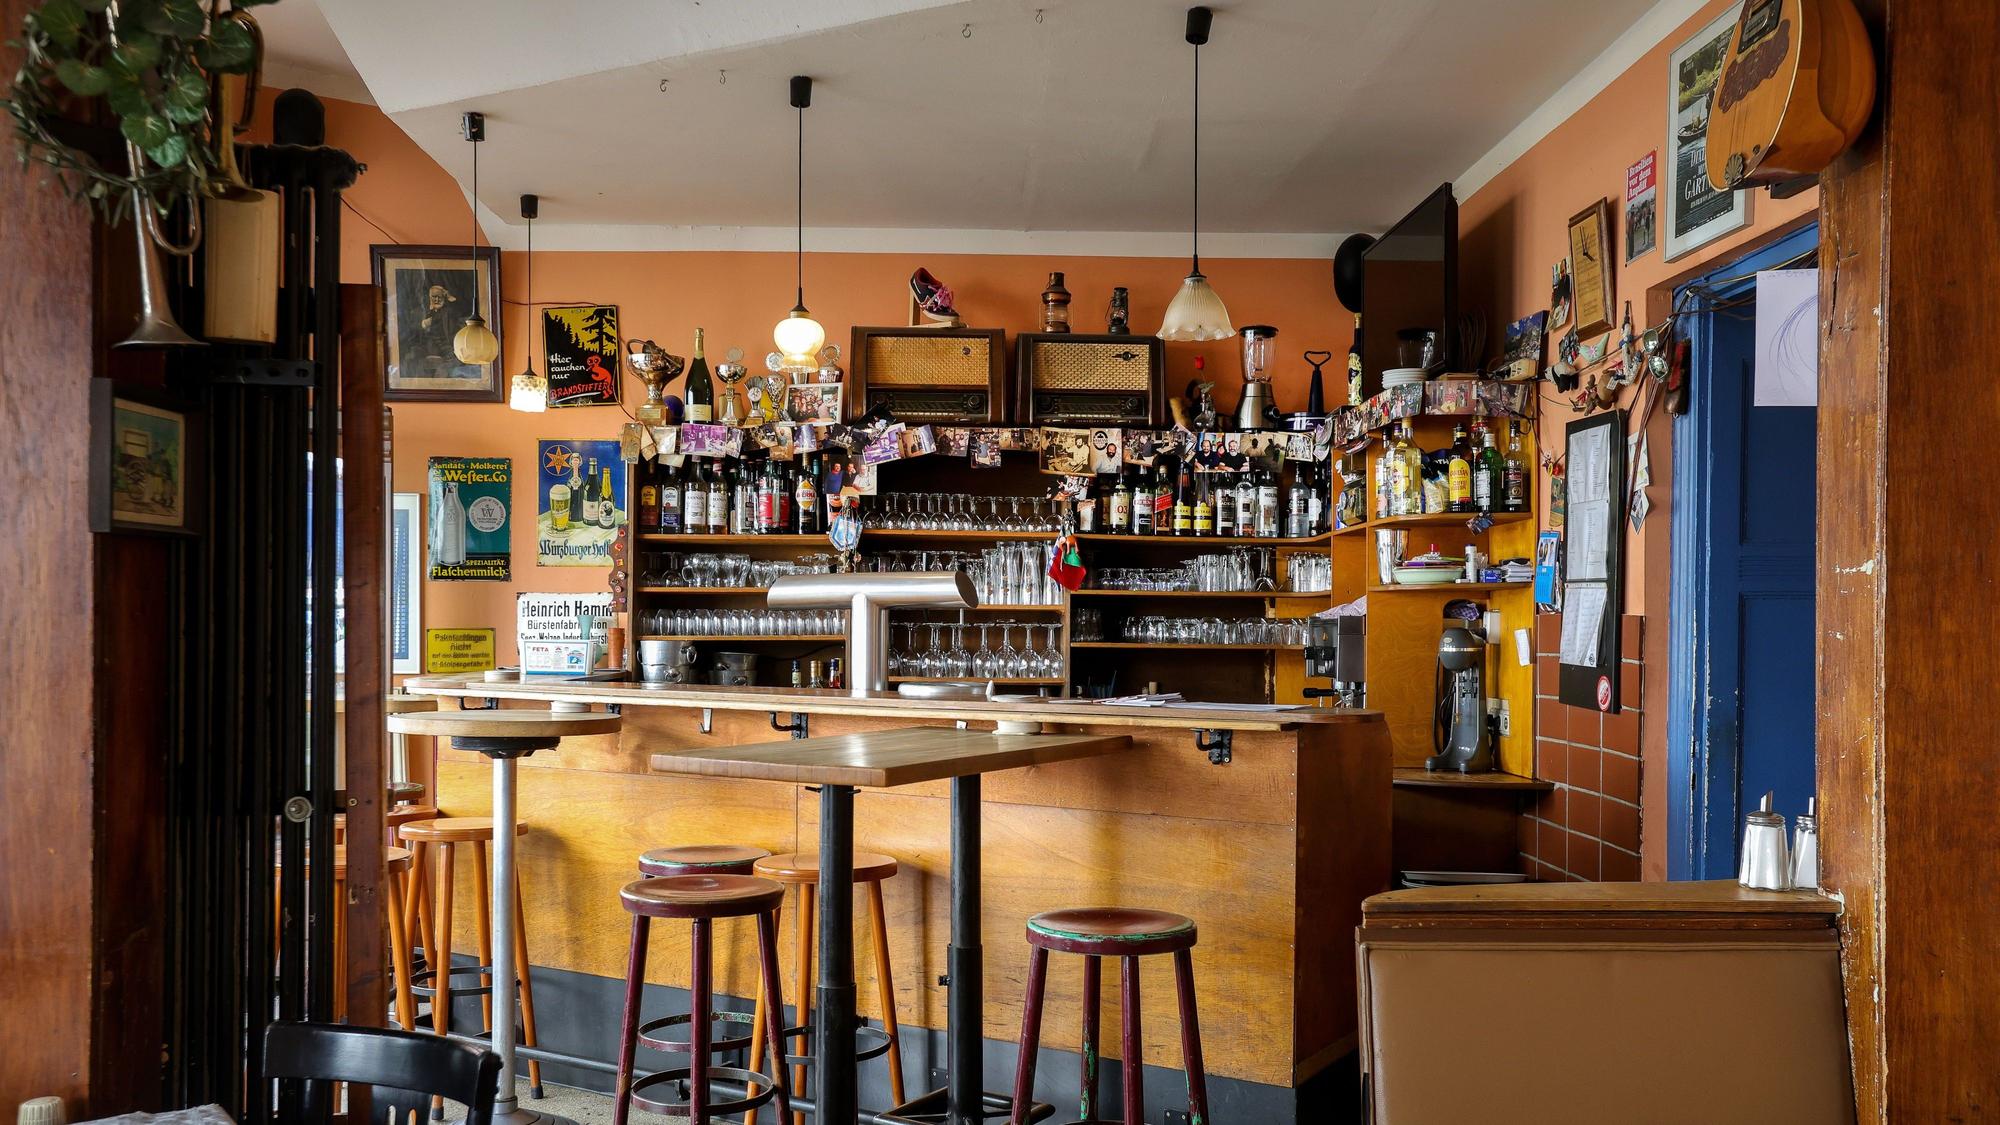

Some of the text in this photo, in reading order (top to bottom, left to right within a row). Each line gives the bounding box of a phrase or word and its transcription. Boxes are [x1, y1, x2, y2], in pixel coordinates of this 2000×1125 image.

[1629, 155, 1653, 177] Brasilien
[1629, 166, 1651, 188] vor dem
[1629, 178, 1647, 199] Anpfiff
[1685, 174, 1706, 200] GÄRT
[550, 353, 571, 364] Hier
[551, 363, 585, 372] rauchen
[550, 382, 609, 400] BRANDSTIFTER
[470, 462, 508, 470] Molkerei
[539, 538, 591, 561] Würzburger
[465, 558, 507, 566] SPEZIALITÄT
[522, 600, 613, 618] Heinrich Hamm
[450, 642, 472, 651] nicht
